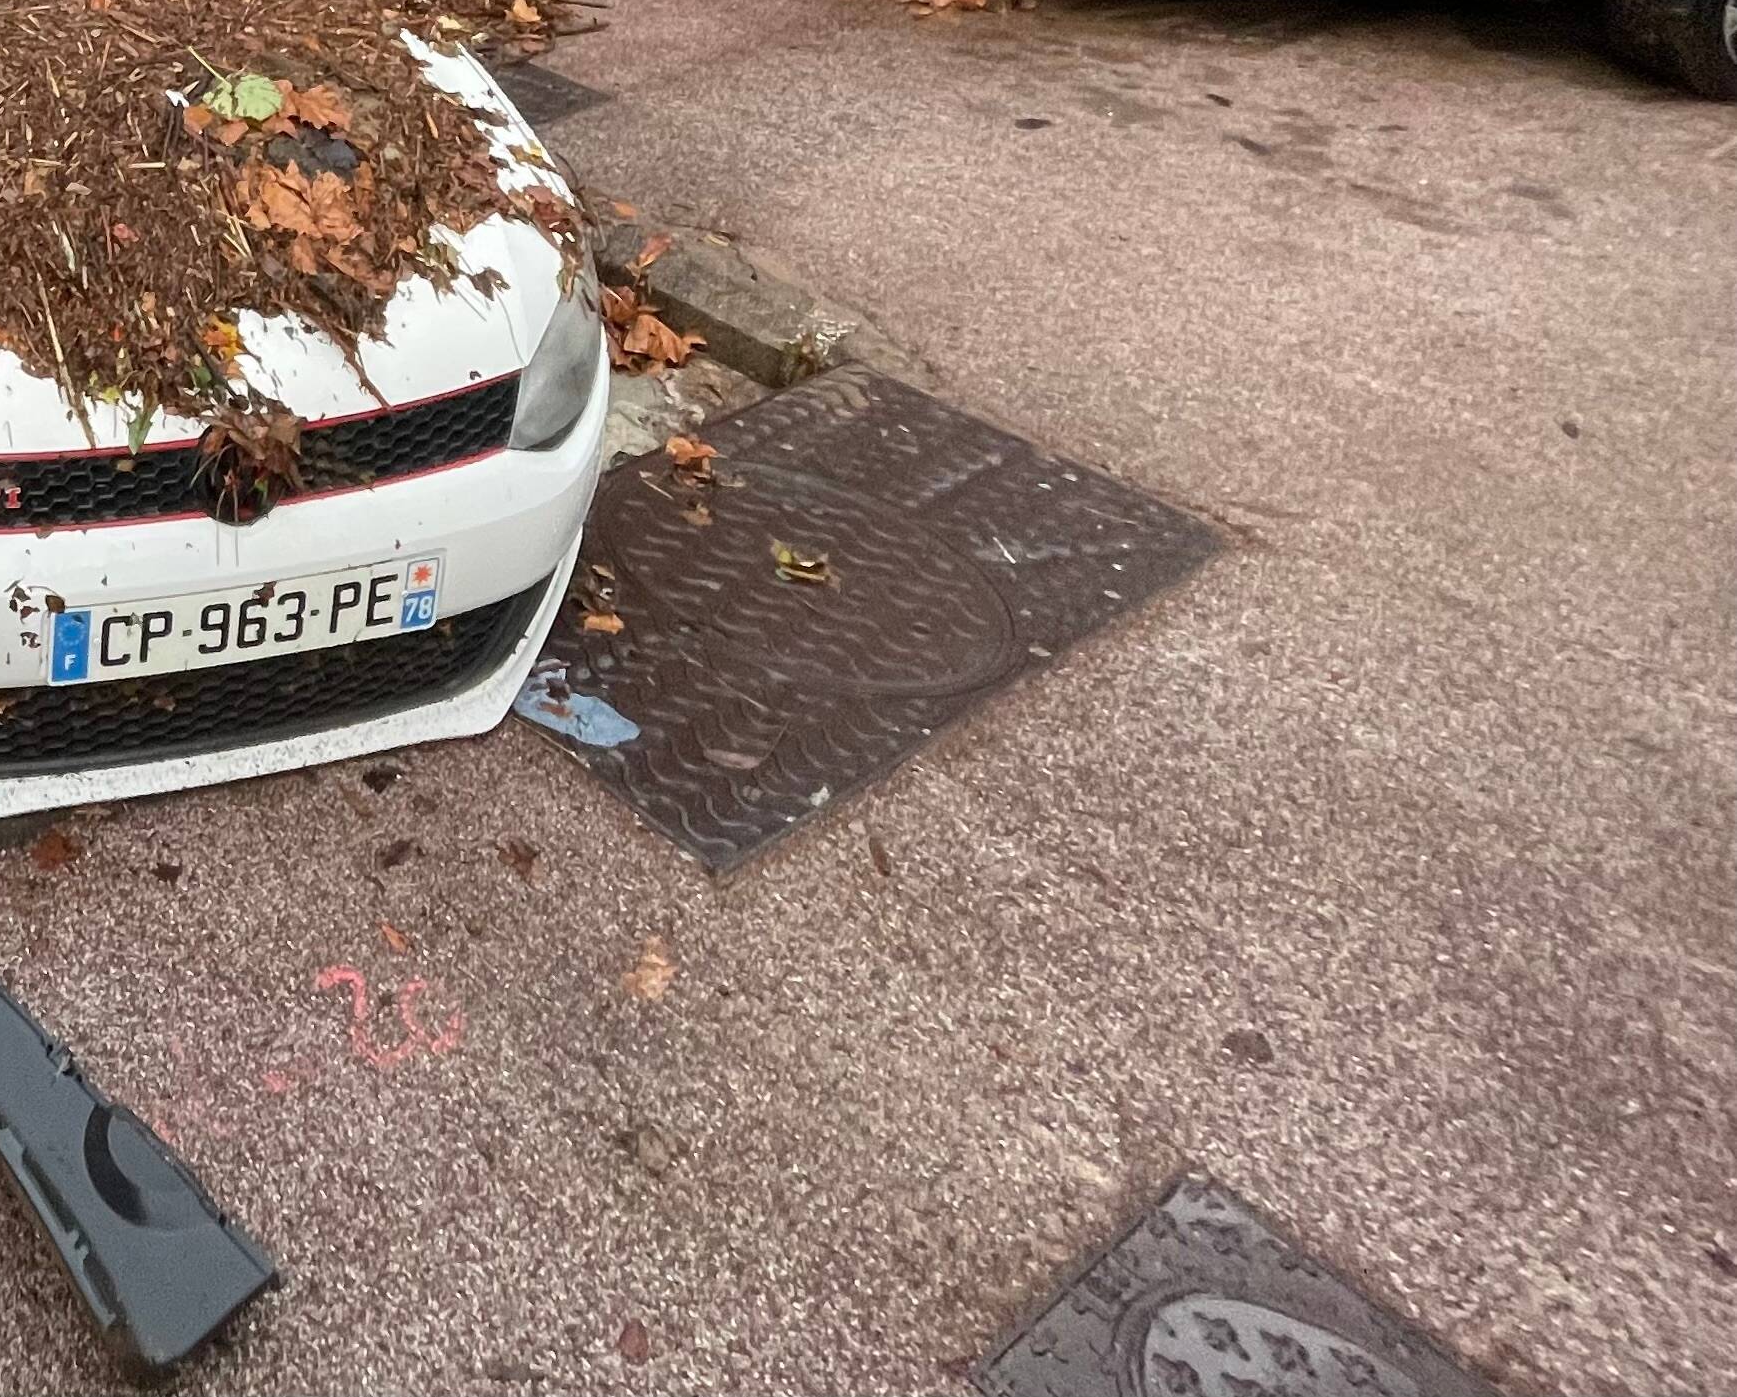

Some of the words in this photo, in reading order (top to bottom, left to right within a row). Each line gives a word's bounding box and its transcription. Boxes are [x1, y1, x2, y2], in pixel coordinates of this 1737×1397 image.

[100, 573, 399, 667] CP-963-PE
[405, 595, 433, 622] 78
[64, 654, 76, 670] F
